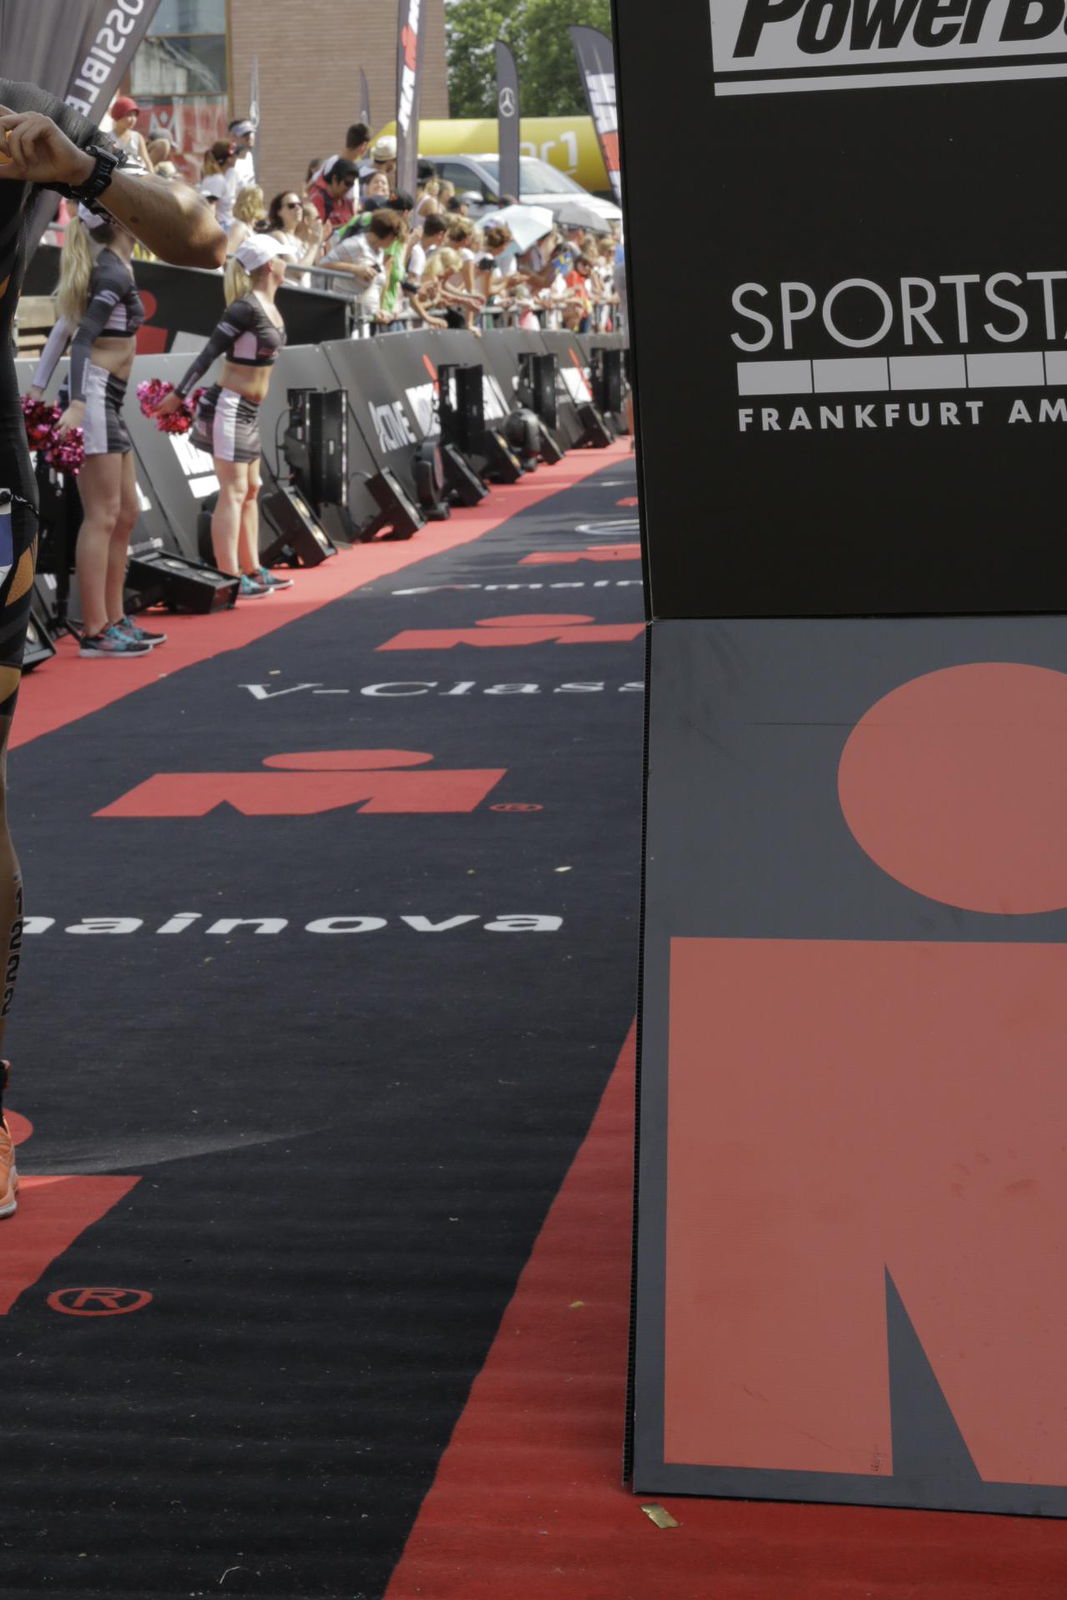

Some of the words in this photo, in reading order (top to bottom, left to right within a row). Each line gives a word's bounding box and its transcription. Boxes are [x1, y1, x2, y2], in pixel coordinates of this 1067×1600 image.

[730, 270, 1067, 352] SPORTST
[737, 400, 984, 433] FRANKFURT
[1007, 398, 1067, 425] AM
